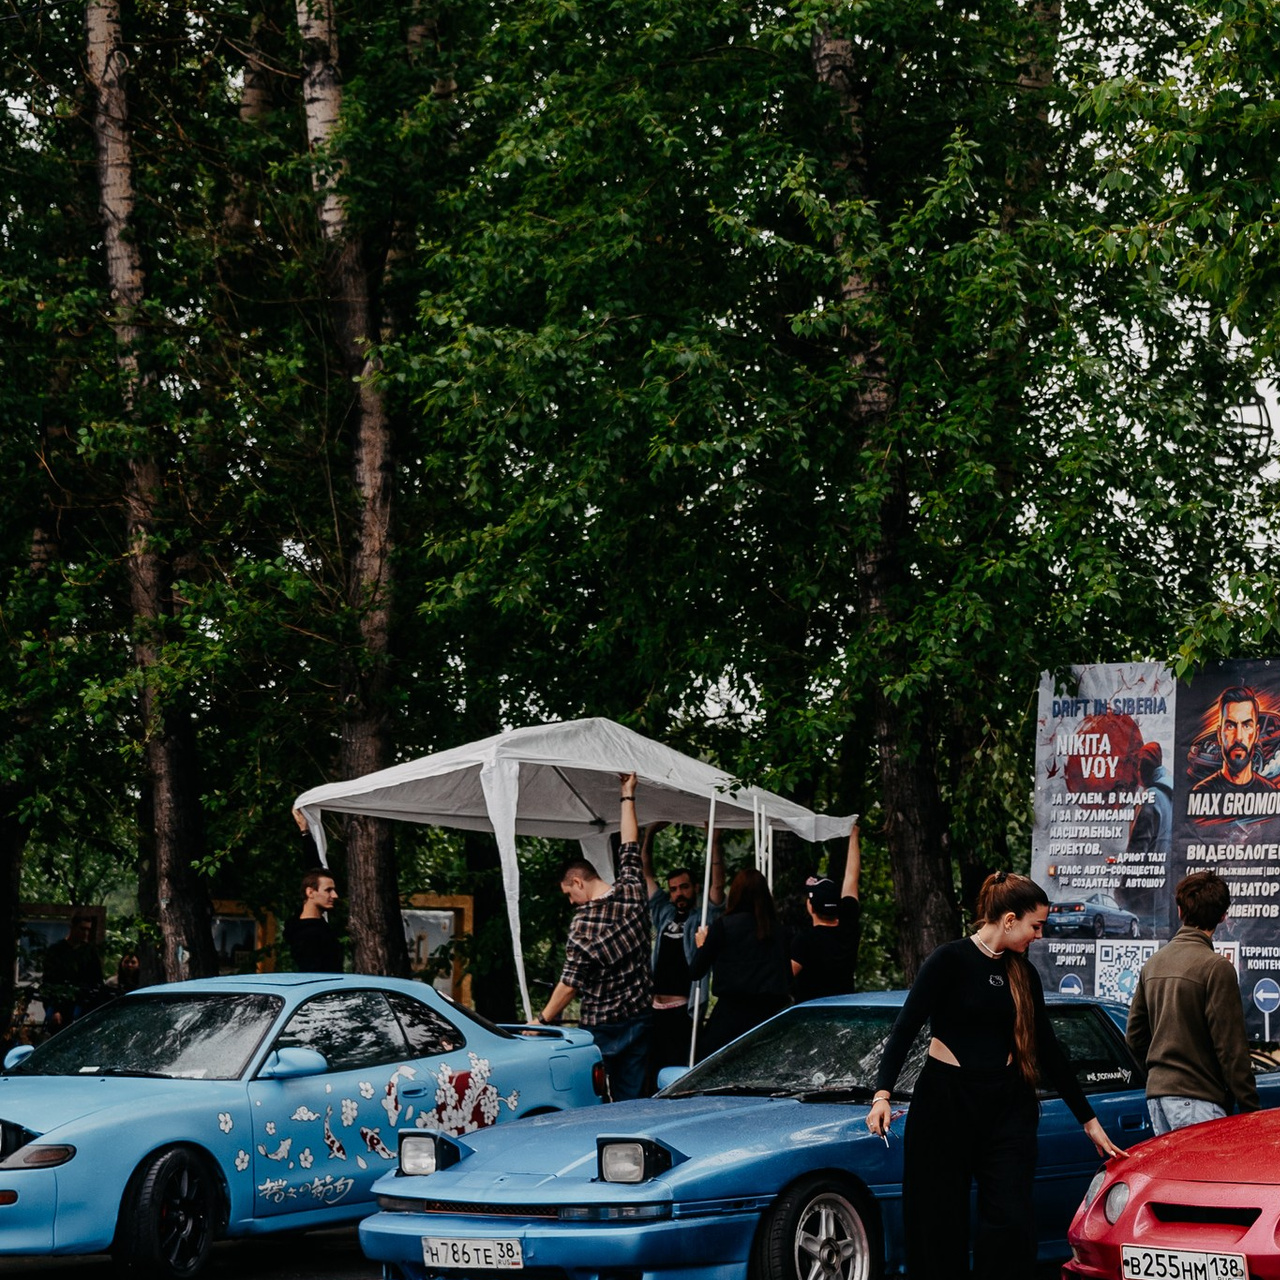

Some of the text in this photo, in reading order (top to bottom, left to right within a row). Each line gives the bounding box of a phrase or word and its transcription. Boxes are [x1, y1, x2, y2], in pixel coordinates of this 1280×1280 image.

[1052, 696, 1167, 718] DRIFT IN SIBERIA
[1056, 733, 1111, 756] NIKITA
[1081, 755, 1119, 779] VOY
[1064, 792, 1105, 806] РУЛЕМ,
[1108, 792, 1116, 804] В
[1118, 791, 1156, 806] КАДРЕ
[1187, 793, 1222, 815] MAX
[1060, 810, 1072, 823] ЗА
[1074, 808, 1135, 822] КУЛИСАМИ
[1049, 825, 1123, 839] МАСШТАБНЫХ
[1048, 842, 1103, 856] ПРОЕКТОВ.
[1116, 852, 1146, 864] ДРИФТ
[1057, 865, 1166, 876] ГОЛОС АВТО-СООБЩЕСТВА
[1071, 877, 1166, 889] СОЗДАТЕЛЬ АВТОШОУ
[1048, 943, 1096, 954] ТЕРРИТОРИЯ
[429, 1242, 515, 1265] Н786ТЕ 38
[1209, 1257, 1242, 1278] 138
